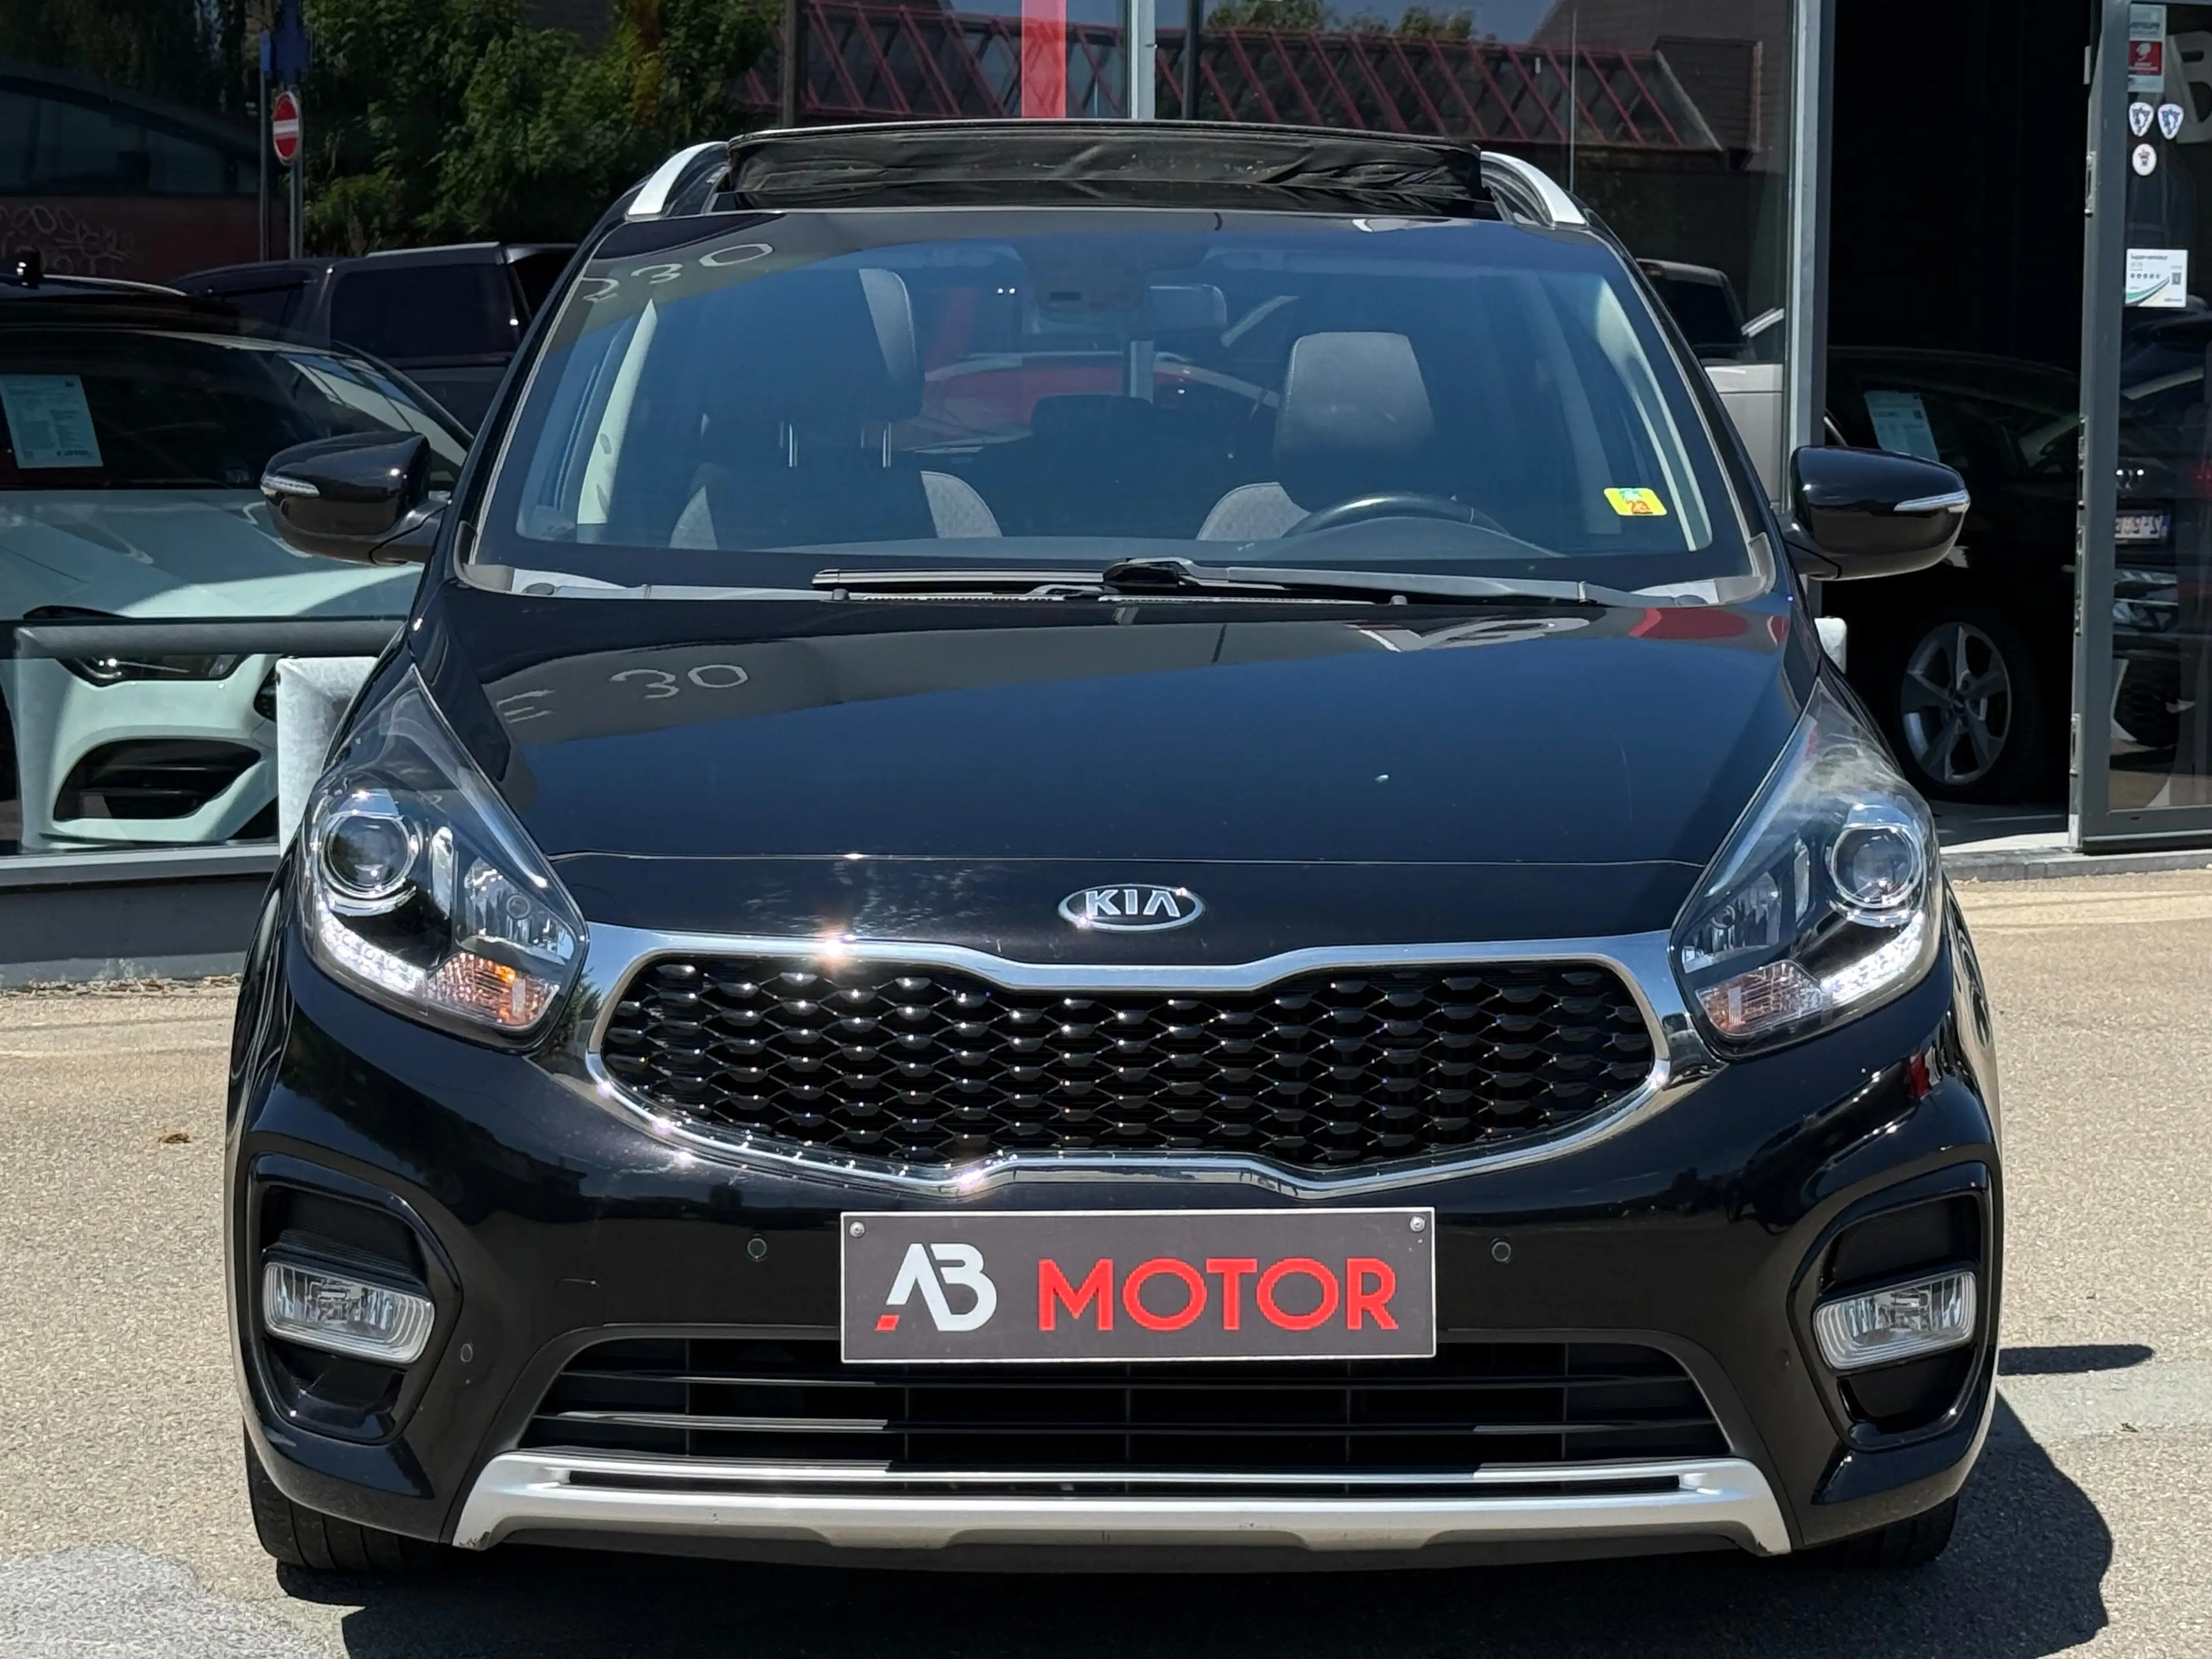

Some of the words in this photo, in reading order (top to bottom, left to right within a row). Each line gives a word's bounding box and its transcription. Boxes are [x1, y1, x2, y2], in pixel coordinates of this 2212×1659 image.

[1085, 888, 1181, 918] KIA
[874, 1243, 998, 1332] AB
[1038, 1257, 1398, 1332] MOTOR
